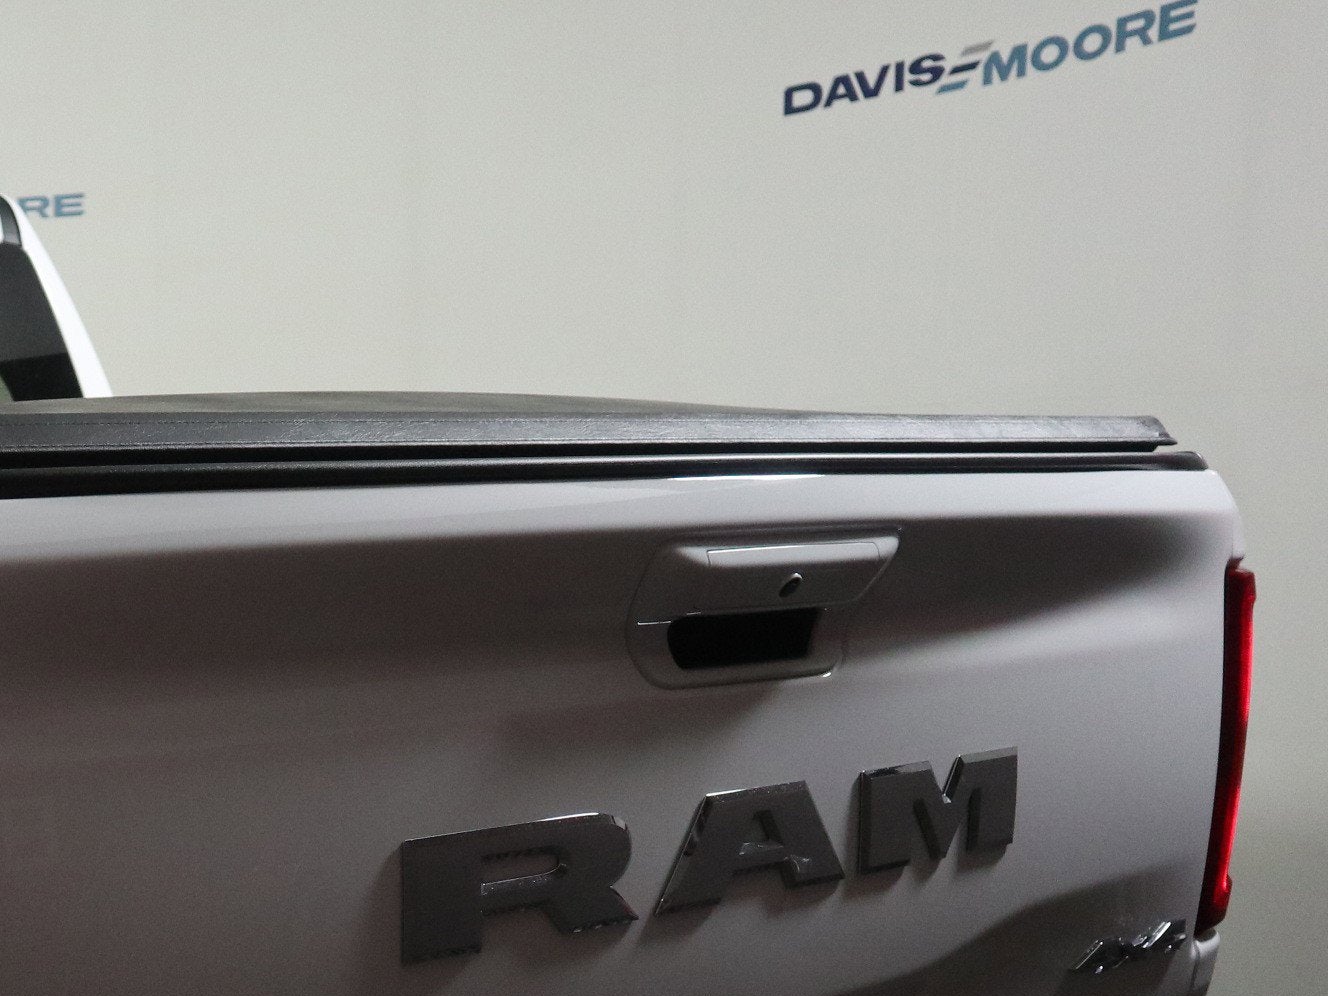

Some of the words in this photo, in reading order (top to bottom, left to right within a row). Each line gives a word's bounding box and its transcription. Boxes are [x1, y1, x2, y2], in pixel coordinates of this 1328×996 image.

[782, 53, 947, 116] DAVIS
[981, 0, 1198, 86] MOORE
[400, 746, 1019, 966] RAM
